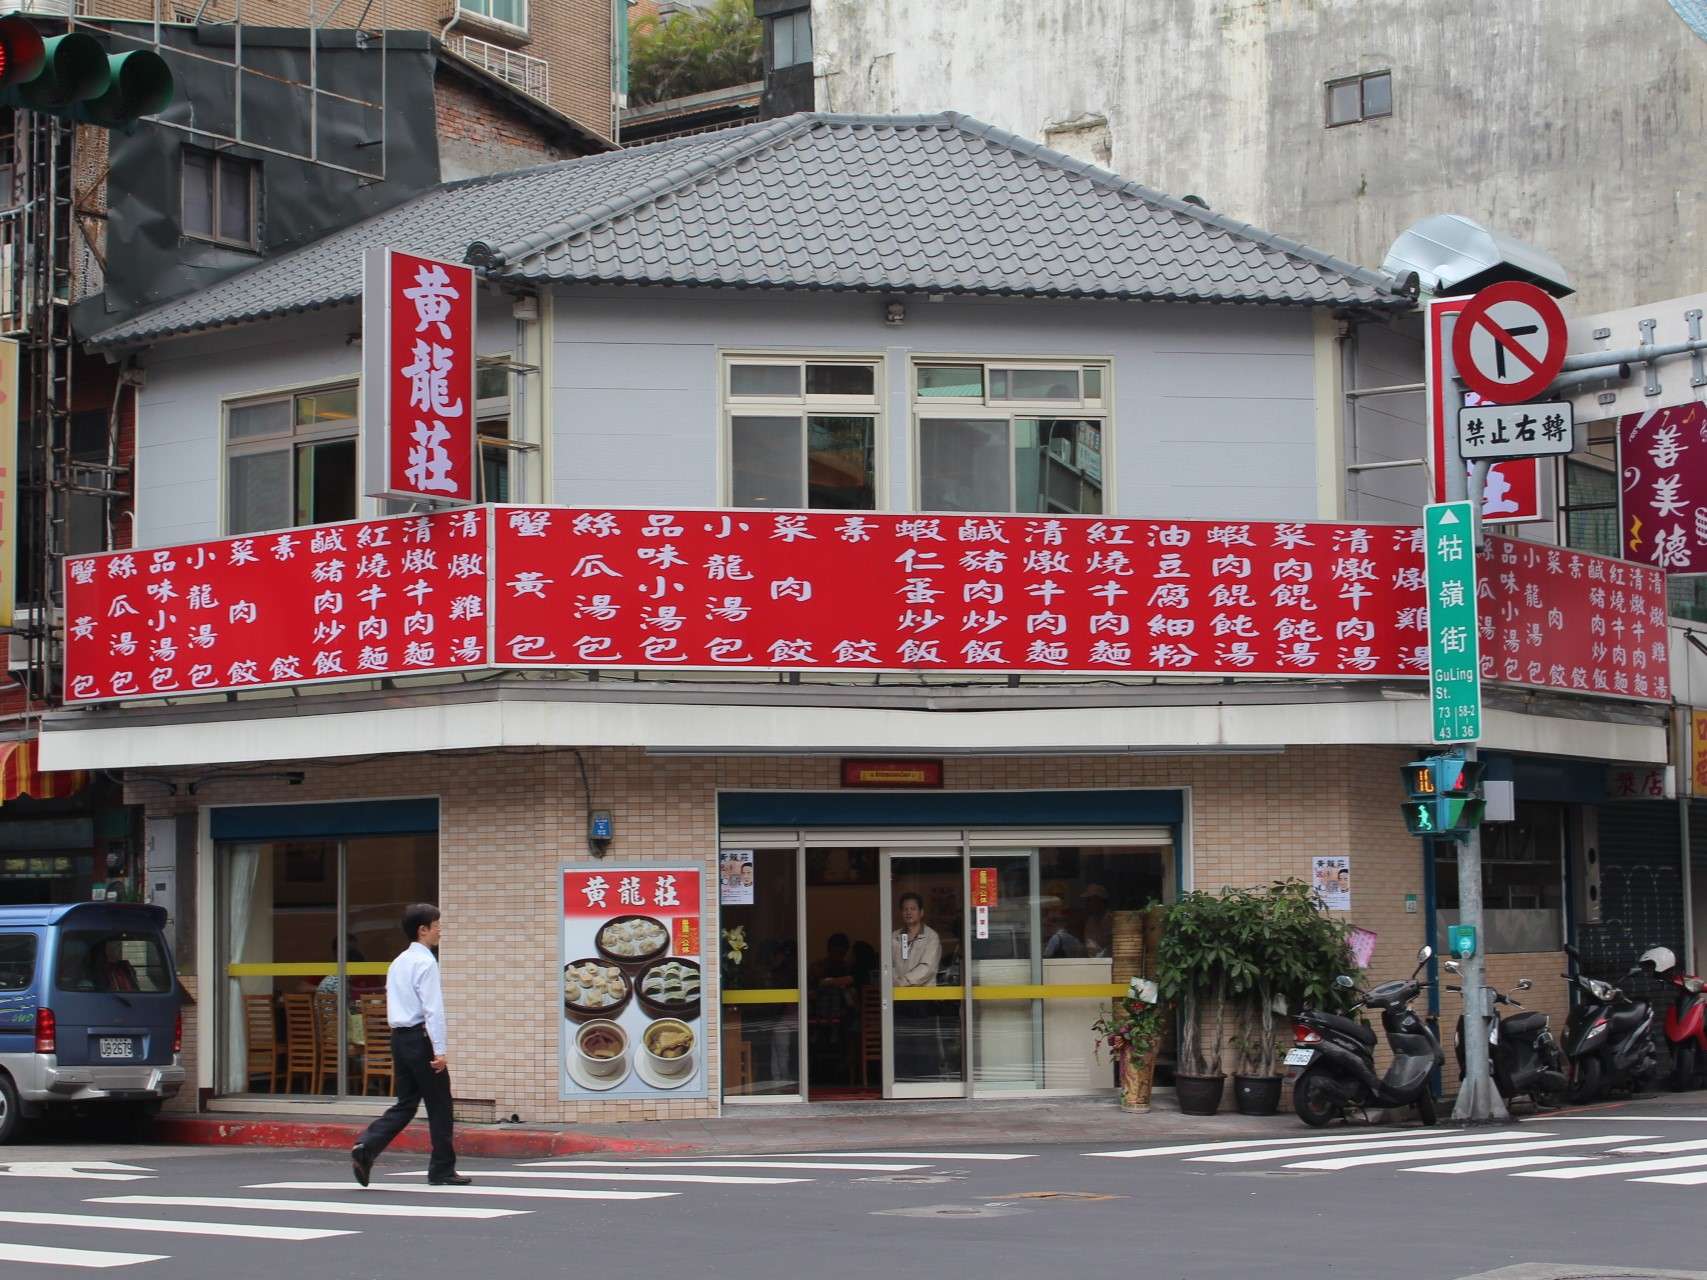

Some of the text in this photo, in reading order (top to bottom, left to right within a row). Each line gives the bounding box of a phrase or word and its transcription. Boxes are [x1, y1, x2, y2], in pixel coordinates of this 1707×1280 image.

[401, 264, 464, 493] 黃龍莊
[1464, 413, 1567, 447] 禁止右轉
[1648, 424, 1692, 568] 善美德
[70, 559, 100, 698] 蟹黃包
[107, 554, 140, 695] 絲瓜湯包
[147, 550, 180, 691] 品味小湯包
[186, 547, 220, 688] 小龍湯包
[227, 539, 261, 685] 菜肉餃
[268, 534, 303, 681] 素餃
[310, 527, 348, 676] 鹹豬肉炒飯
[356, 524, 392, 671] 紅燒牛肉麵
[401, 516, 438, 667] 清燉牛肉麵
[447, 510, 485, 663] 清燉雞湯
[505, 510, 556, 661] 蟹黃包
[570, 512, 624, 661] 絲瓜湯包
[637, 514, 688, 662] 品味小湯包
[702, 515, 754, 663] 小龍湯包
[766, 515, 819, 664] 菜肉餃
[831, 516, 883, 664] 素餃
[895, 519, 946, 663] 蝦仁蛋炒飯
[958, 518, 1010, 664] 鹹豬肉炒飯
[1023, 519, 1072, 666] 清燉牛肉麵
[1085, 521, 1134, 666] 紅燒牛肉麵
[1147, 524, 1199, 667] 油豆腐細粉
[1206, 524, 1260, 667] 蝦肉餛飩湯
[1269, 523, 1323, 668] 菜肉餛飩湯
[1331, 527, 1380, 671] 清燉牛肉湯
[1437, 533, 1467, 655] 牯嶺街
[1500, 542, 1522, 682] 品味小湯包
[1523, 547, 1545, 684] 小龍湯包
[1547, 550, 1567, 687] 菜肉餃
[1568, 554, 1589, 689] 素餃
[1588, 559, 1610, 691] 鹹豬肉炒飯
[1609, 564, 1629, 694] 紅燒牛肉麵
[1629, 567, 1648, 696] 清燉牛肉麵
[1648, 571, 1668, 698] 清燉雞湯
[1435, 668, 1473, 682] GuLing
[1436, 687, 1451, 699] St.
[1438, 705, 1475, 718] 73 58-2
[1439, 726, 1474, 738] 43 36
[581, 874, 680, 908] 黃龍莊
